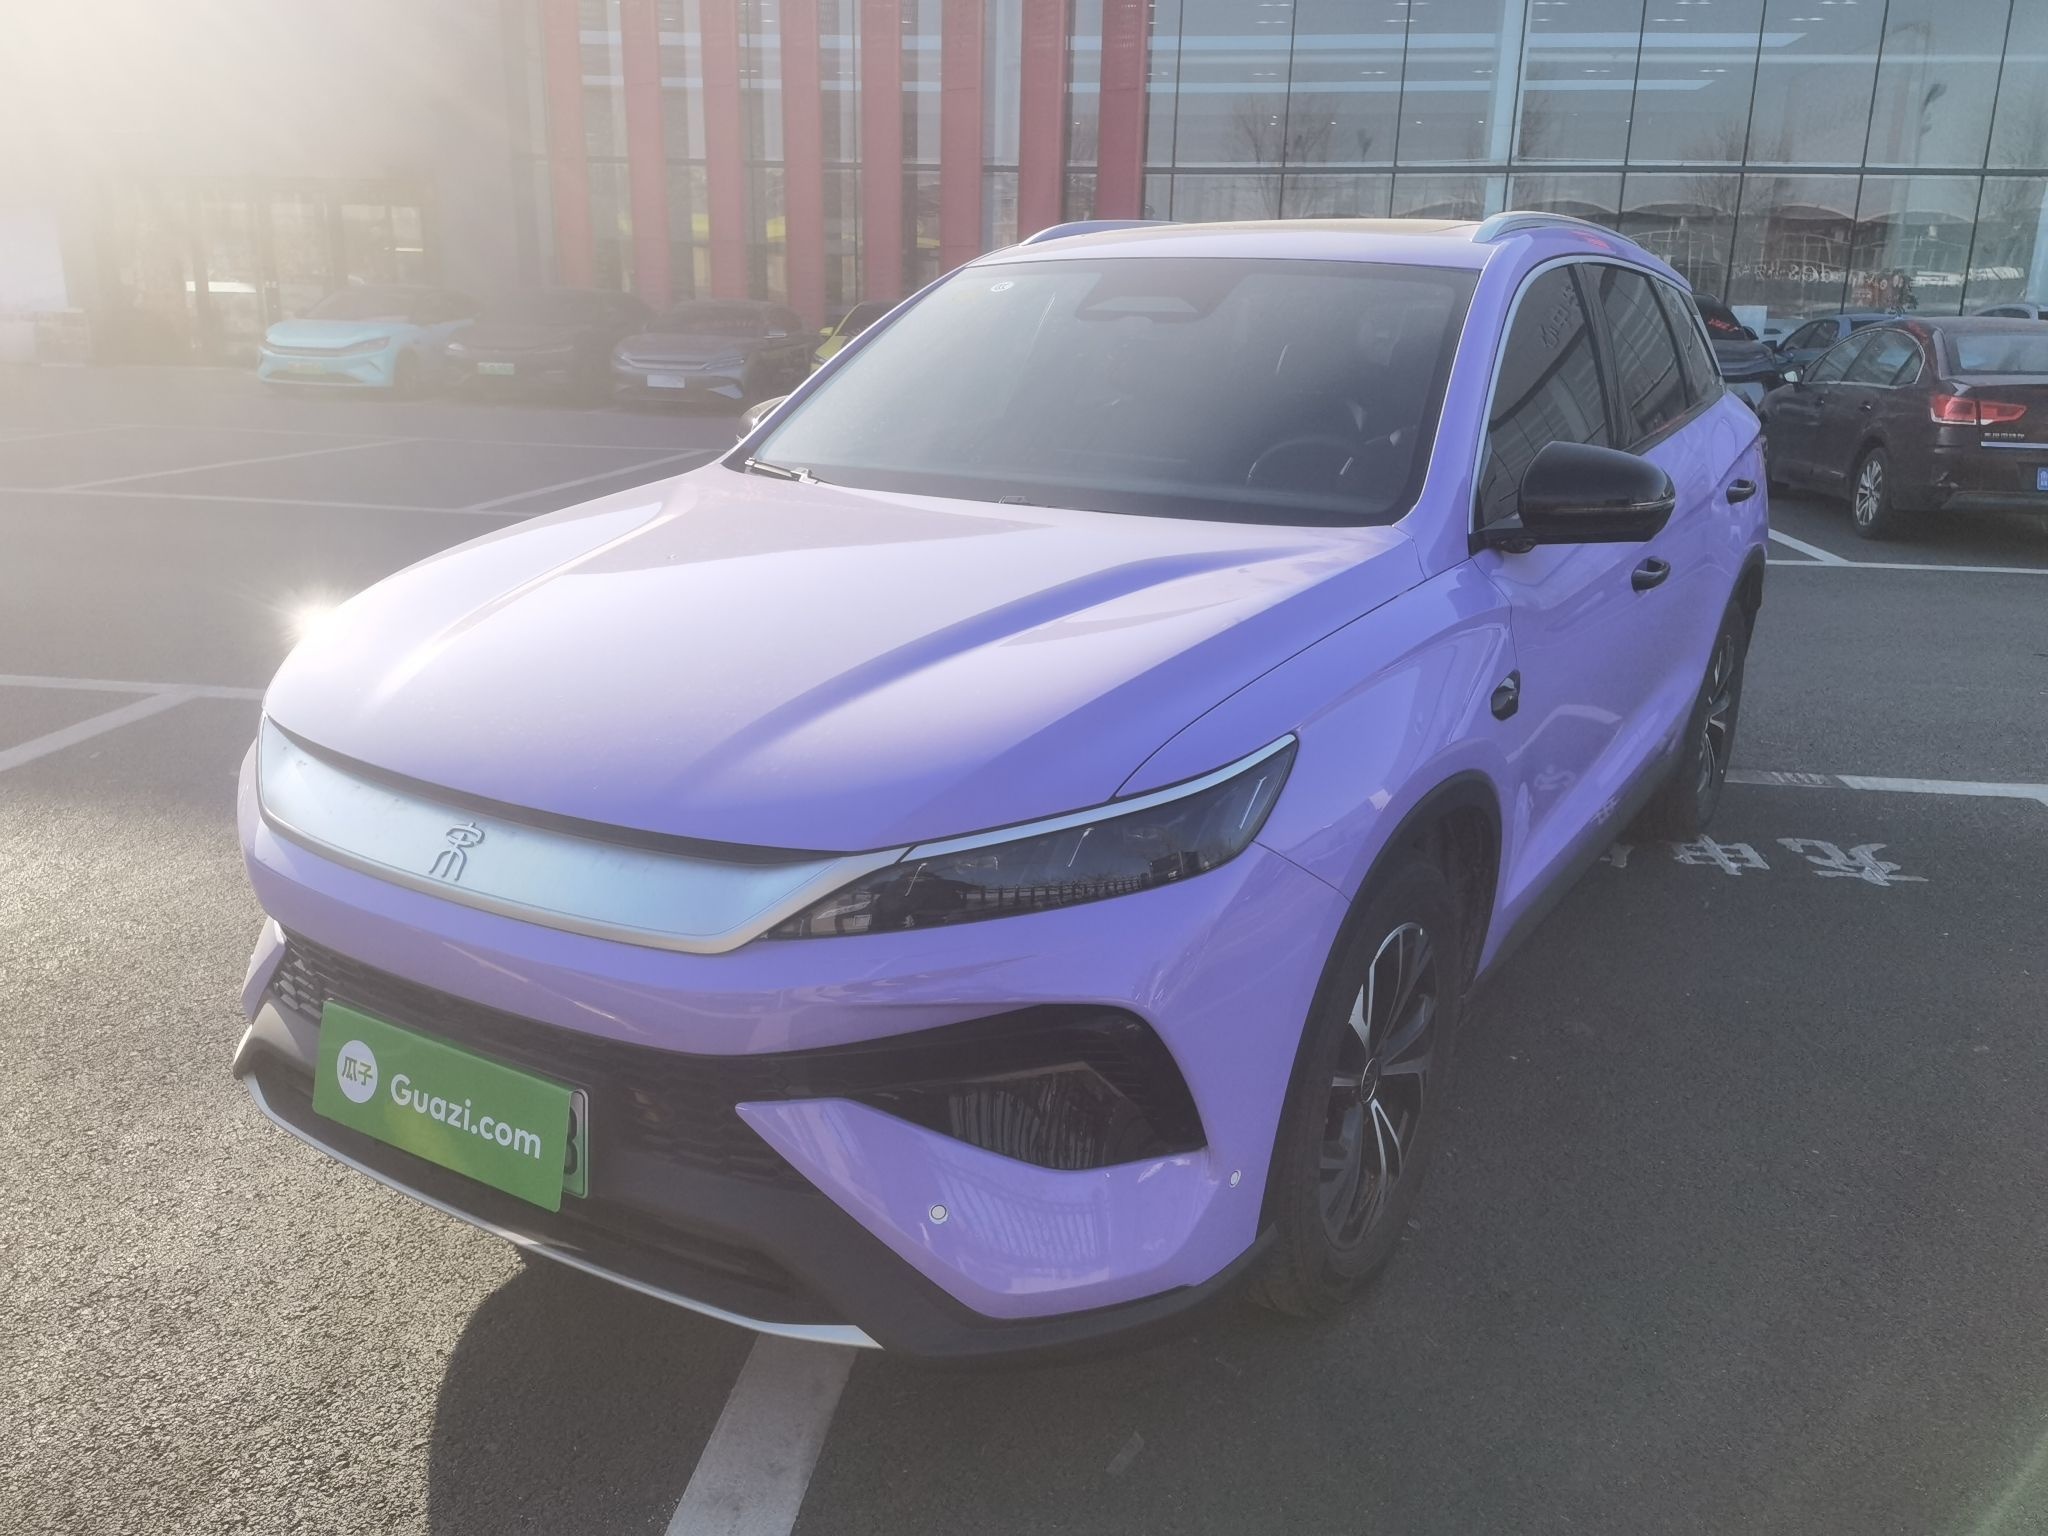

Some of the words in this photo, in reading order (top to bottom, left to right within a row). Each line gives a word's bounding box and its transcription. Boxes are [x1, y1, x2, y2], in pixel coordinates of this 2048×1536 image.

[1600, 834, 1929, 887] 充电
[341, 1056, 373, 1086] 瓜子
[390, 1073, 541, 1159] Guazi.com
